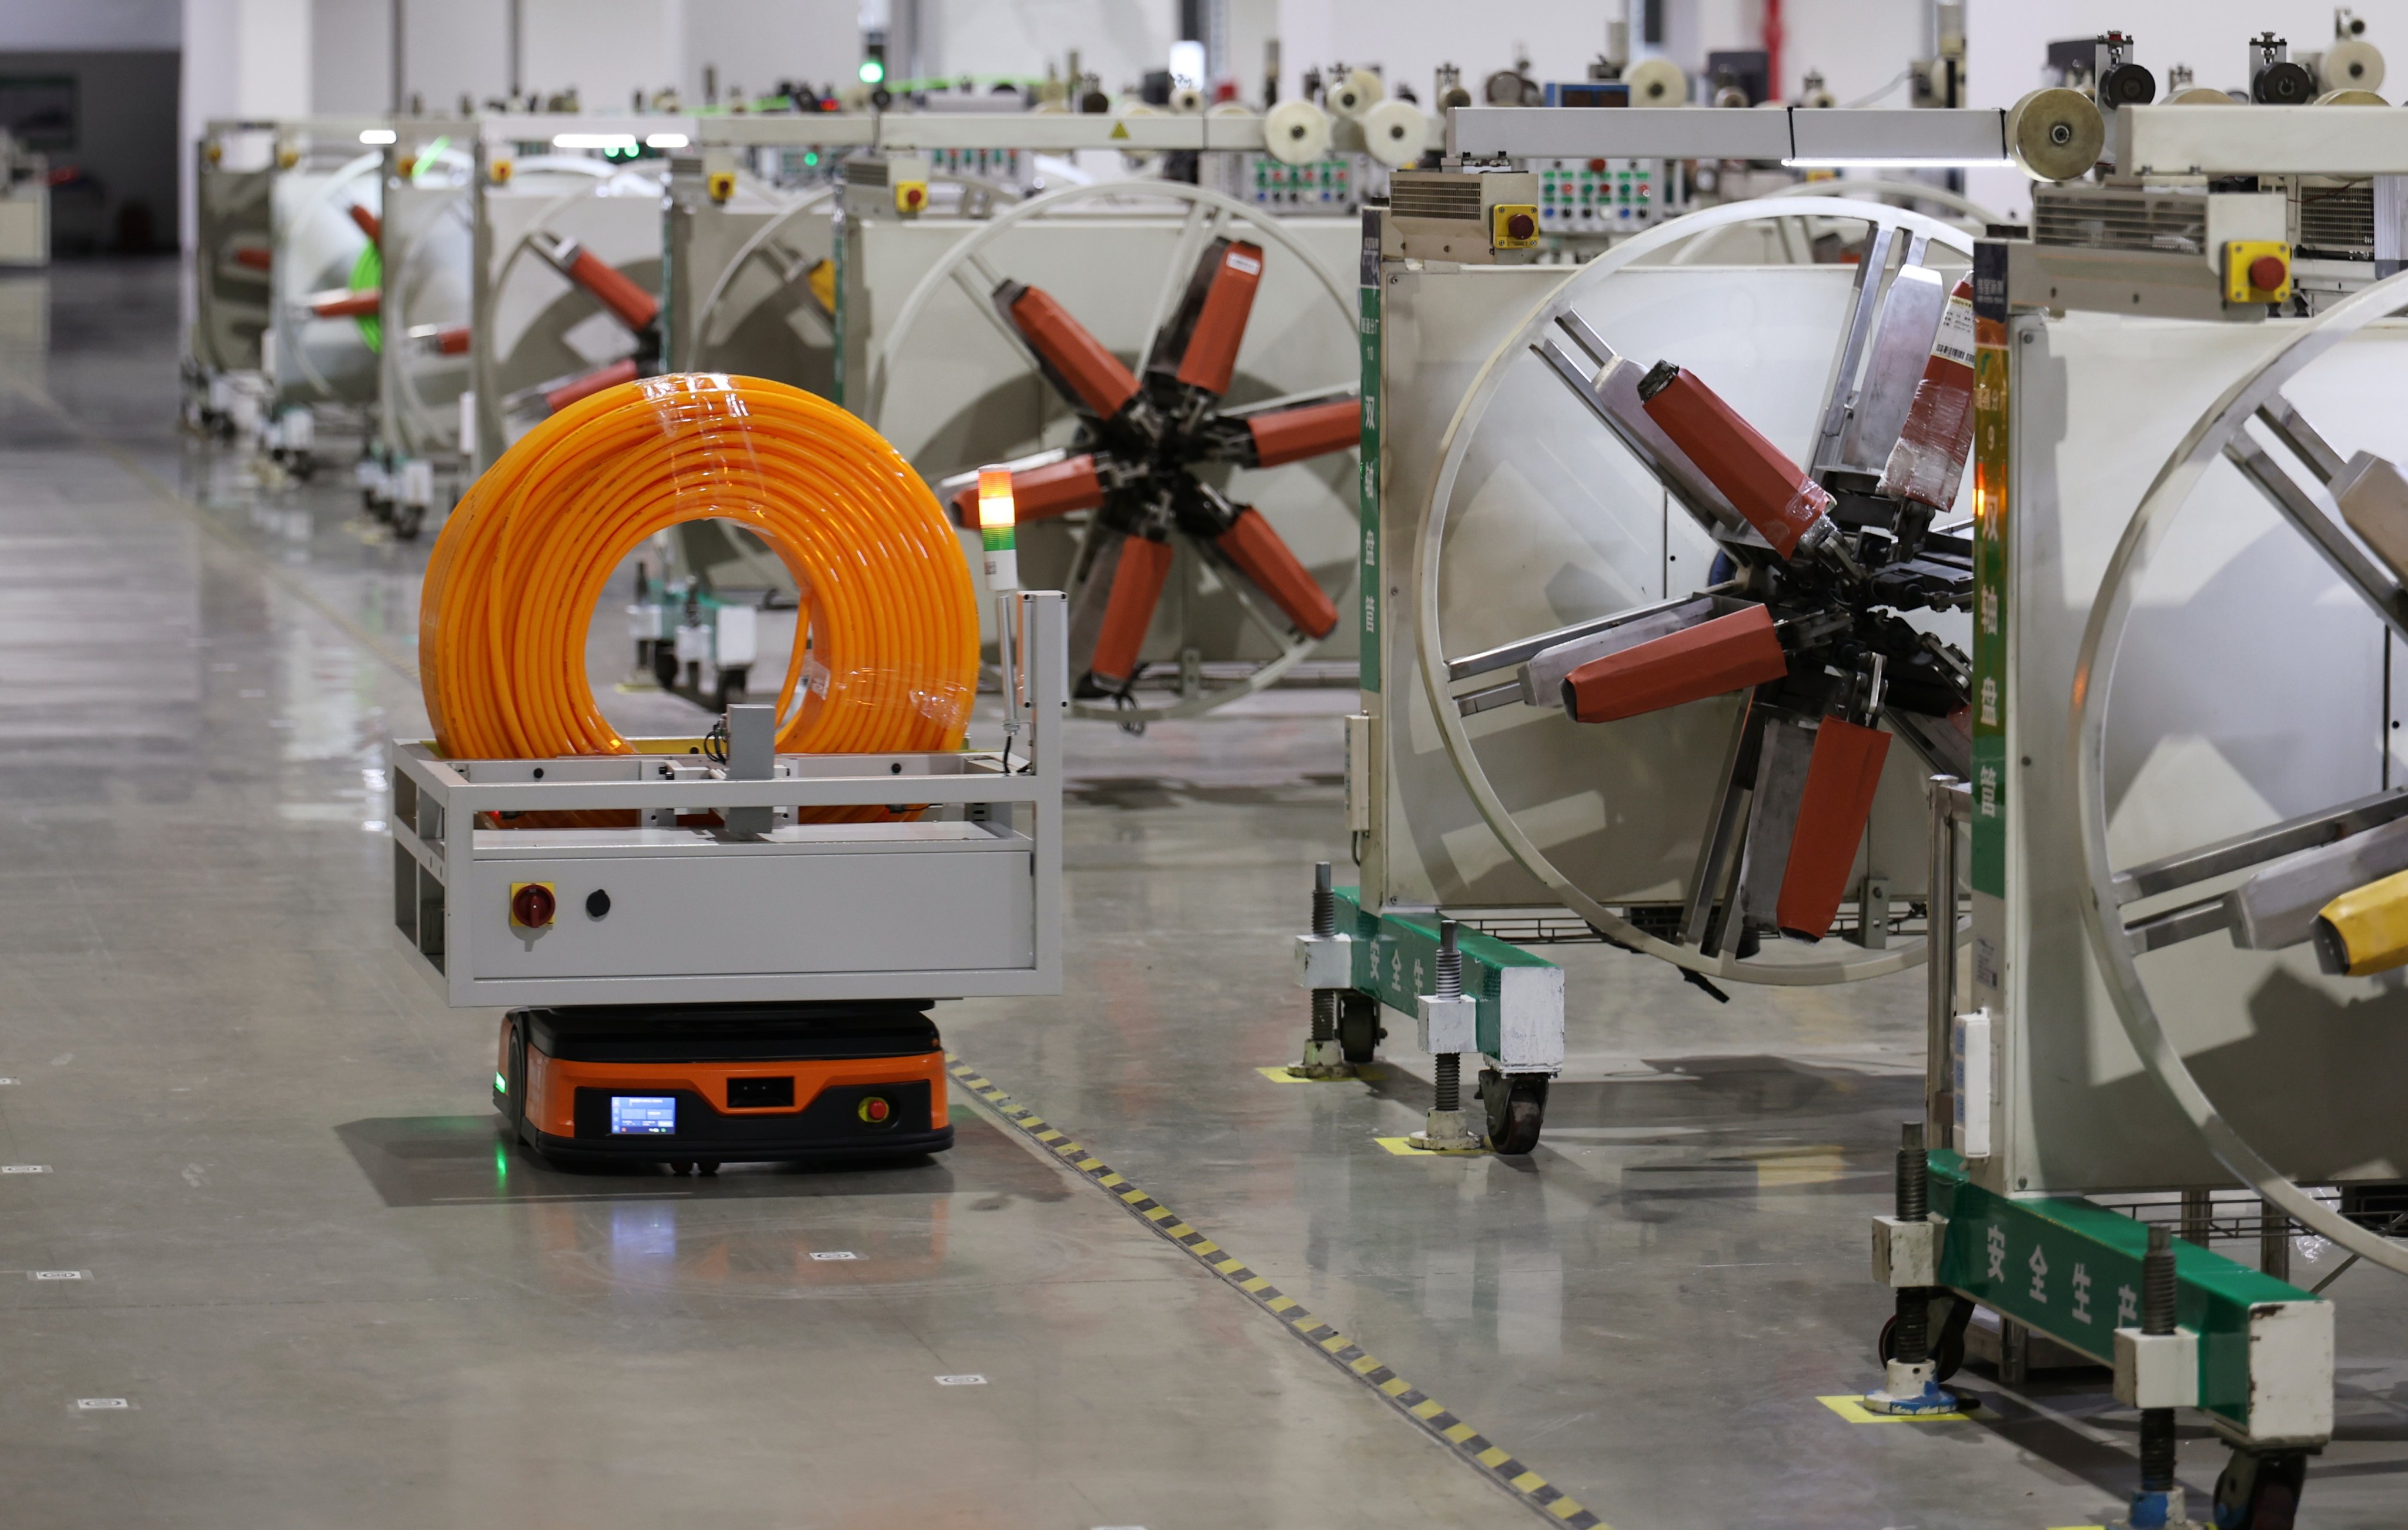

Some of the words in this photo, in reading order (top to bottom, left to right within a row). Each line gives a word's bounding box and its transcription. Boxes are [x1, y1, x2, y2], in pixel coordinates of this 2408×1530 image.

[1987, 424, 1995, 450] 9
[1980, 494, 1999, 818] 双轴盘管
[1987, 1224, 2138, 1328] 安全生产
